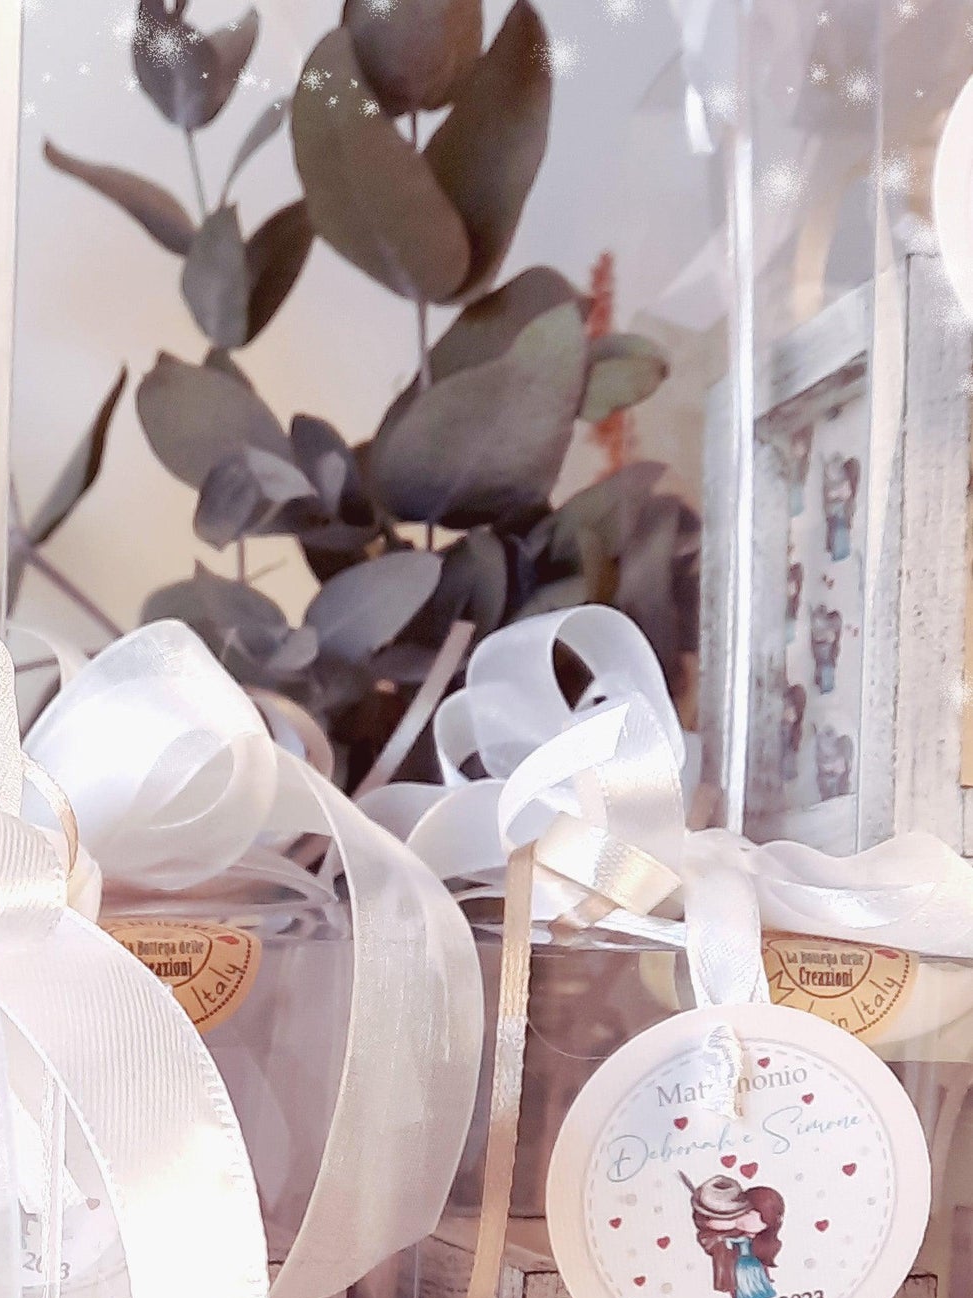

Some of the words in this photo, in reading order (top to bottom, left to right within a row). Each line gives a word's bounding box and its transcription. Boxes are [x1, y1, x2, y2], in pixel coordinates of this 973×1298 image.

[146, 957, 193, 977] eazioni
[190, 964, 246, 1013] Italy
[799, 966, 853, 987] Creazioni
[851, 977, 903, 1024] Italy
[763, 1106, 862, 1155] Simone
